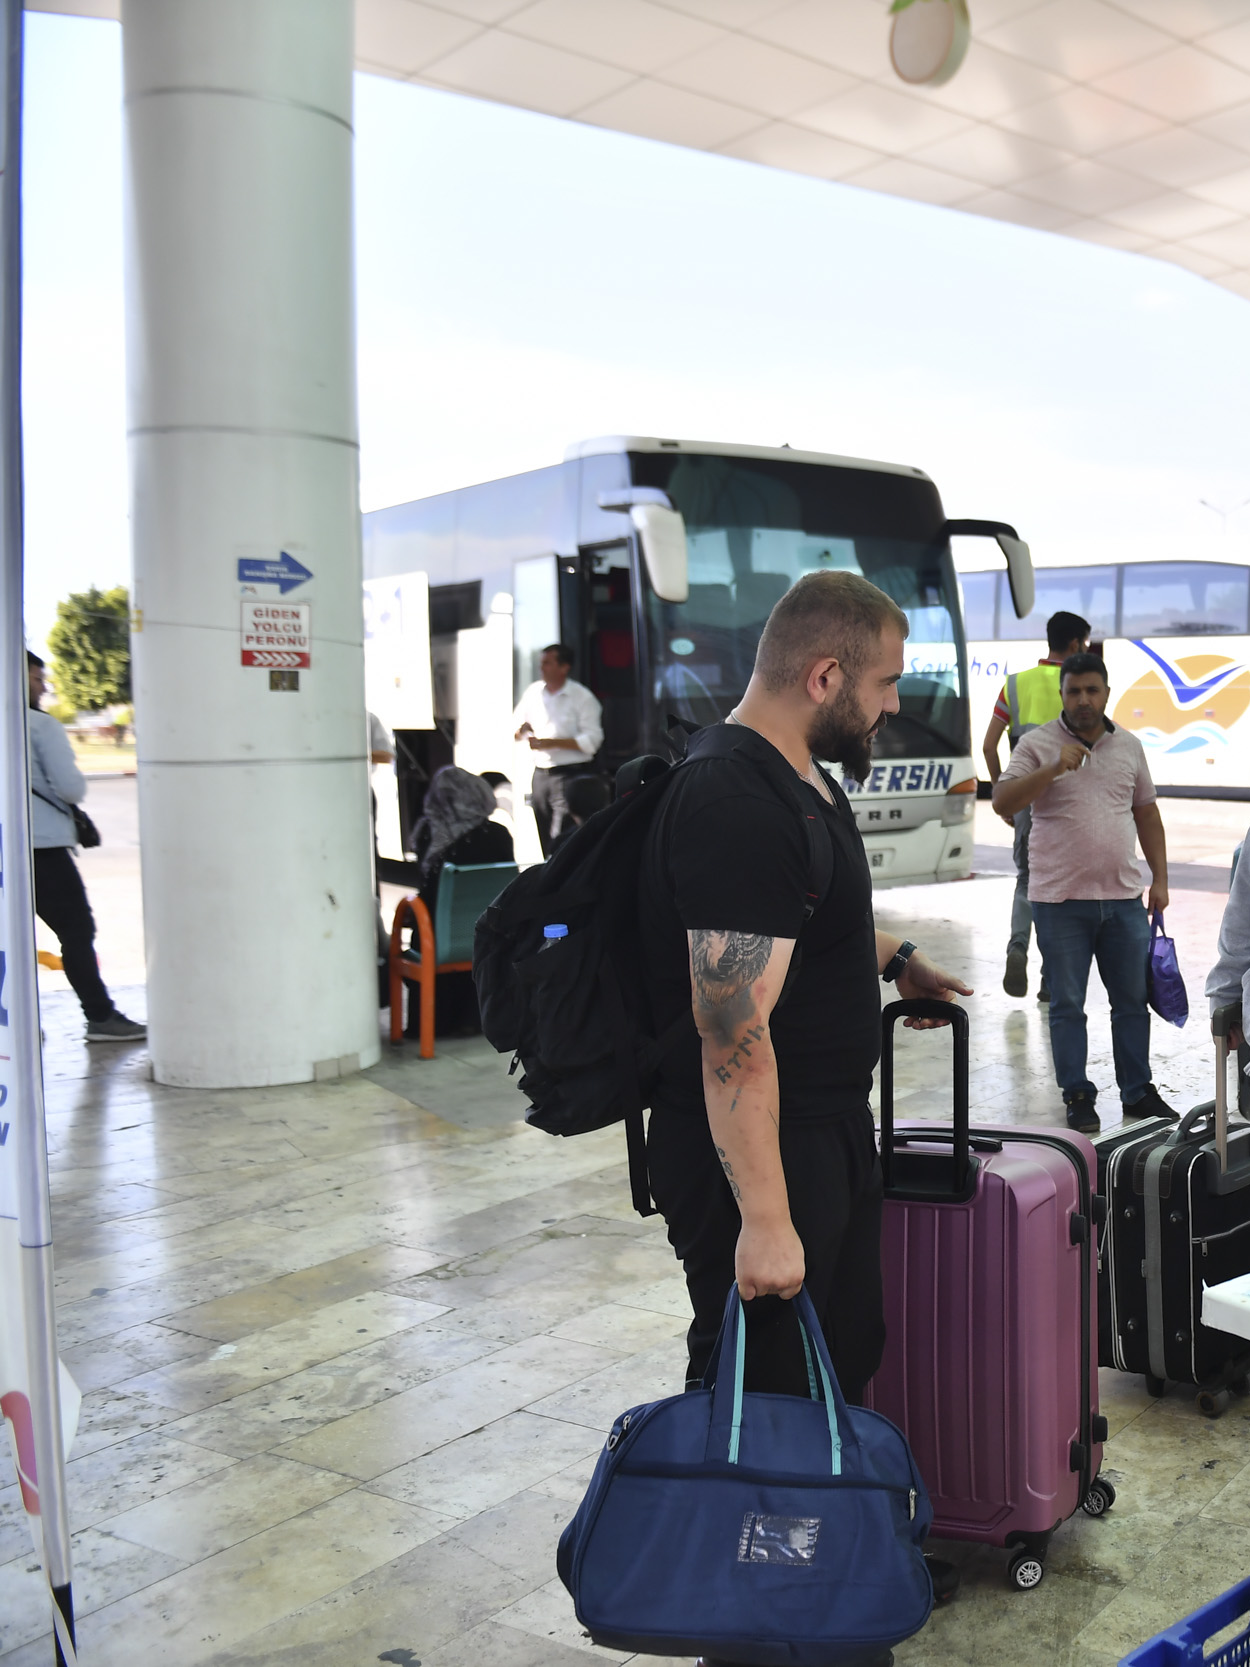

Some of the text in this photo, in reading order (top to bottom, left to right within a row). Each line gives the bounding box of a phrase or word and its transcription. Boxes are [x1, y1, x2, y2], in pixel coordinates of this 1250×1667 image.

[253, 607, 301, 620] GİDEN
[253, 621, 303, 634] YOLCU
[245, 635, 307, 647] PERONU
